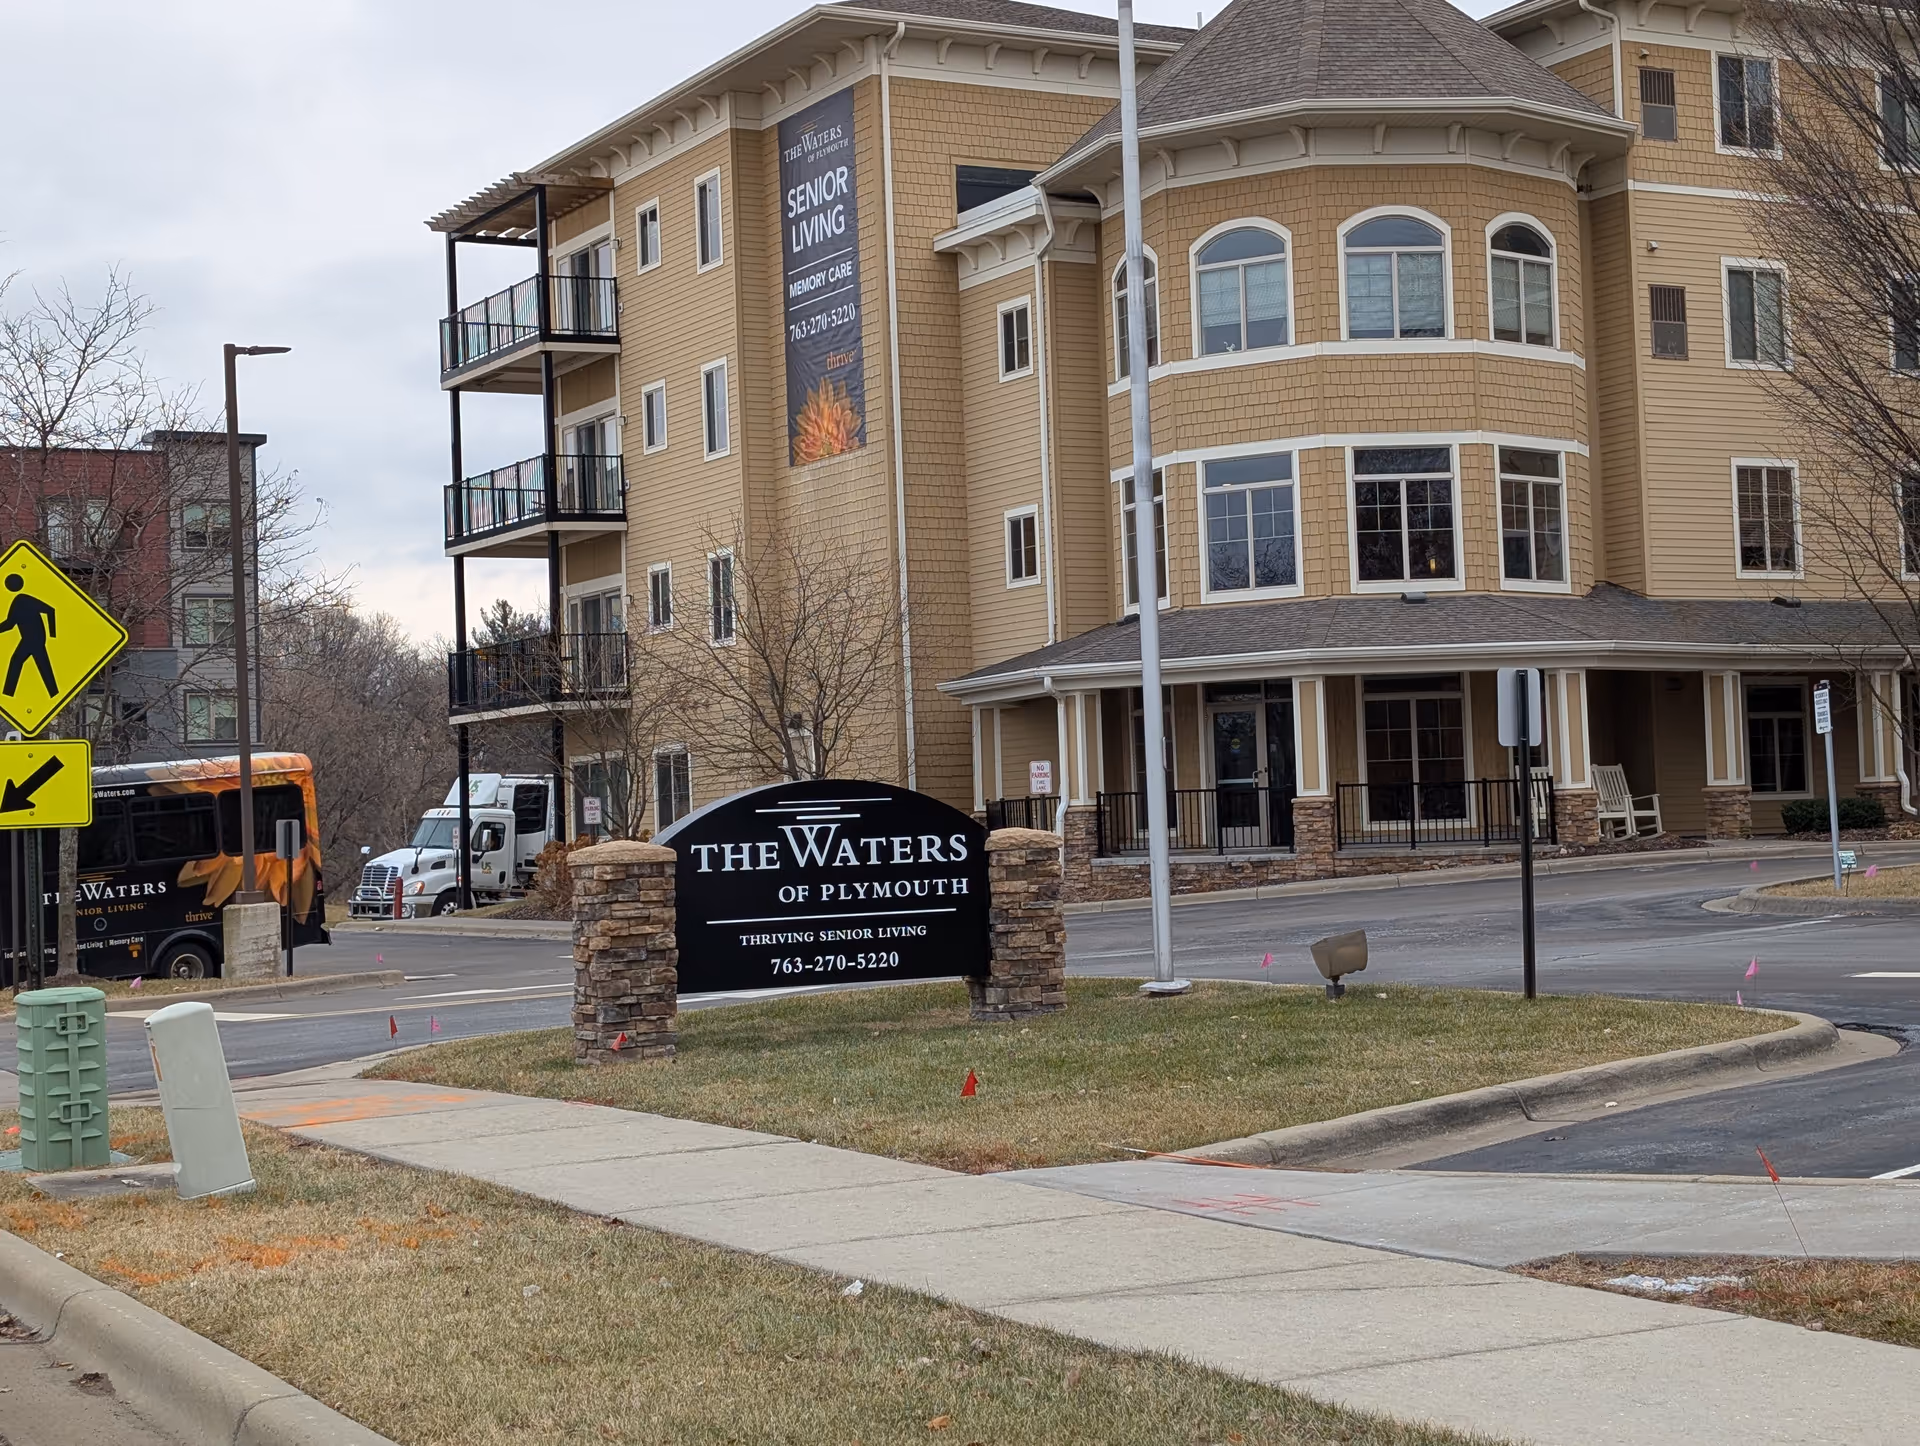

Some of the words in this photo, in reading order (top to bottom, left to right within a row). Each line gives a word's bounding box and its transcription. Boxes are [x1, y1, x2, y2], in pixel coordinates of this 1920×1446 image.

[784, 143, 803, 163] THE
[801, 125, 842, 152] WATERS
[807, 153, 815, 163] OF
[816, 138, 849, 160] PLYMOUTH
[787, 165, 849, 219] SENIOR
[792, 204, 846, 254] LIVING
[789, 272, 827, 299] MEMORY
[828, 260, 853, 282] CARE
[826, 349, 854, 370] thrive
[93, 789, 136, 799] eWaters.com
[691, 841, 781, 873] THE
[777, 823, 968, 868] WATERS
[80, 881, 167, 901] WATERS
[778, 885, 809, 903] OF
[821, 878, 970, 902] PLYMOUTH
[76, 907, 103, 917] NIOR
[108, 902, 145, 914] LIVING
[185, 911, 213, 922] thrive
[739, 930, 815, 946] THRIVING
[819, 928, 874, 942] SENIOR
[877, 925, 927, 939] LIVING
[770, 951, 900, 975] 763-270-5220
